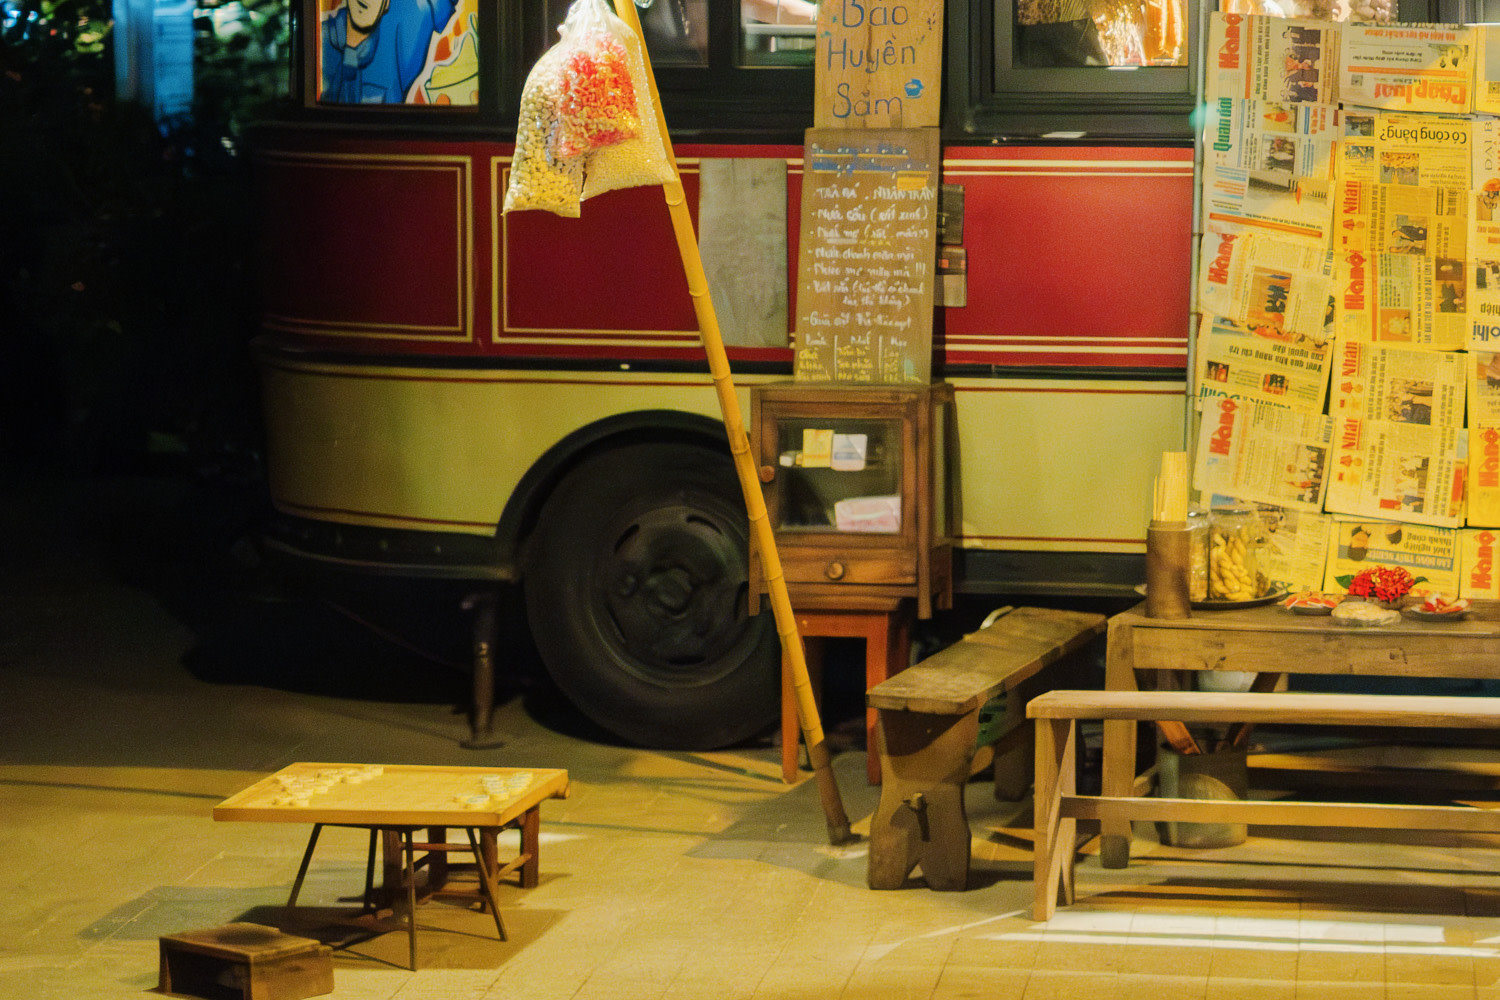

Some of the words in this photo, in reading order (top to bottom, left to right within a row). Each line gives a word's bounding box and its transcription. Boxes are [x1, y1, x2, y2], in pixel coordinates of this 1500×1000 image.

[828, 33, 915, 73] Huyền
[1380, 126, 1418, 145] bằng?
[1421, 127, 1450, 143] công
[1452, 132, 1466, 144] Có
